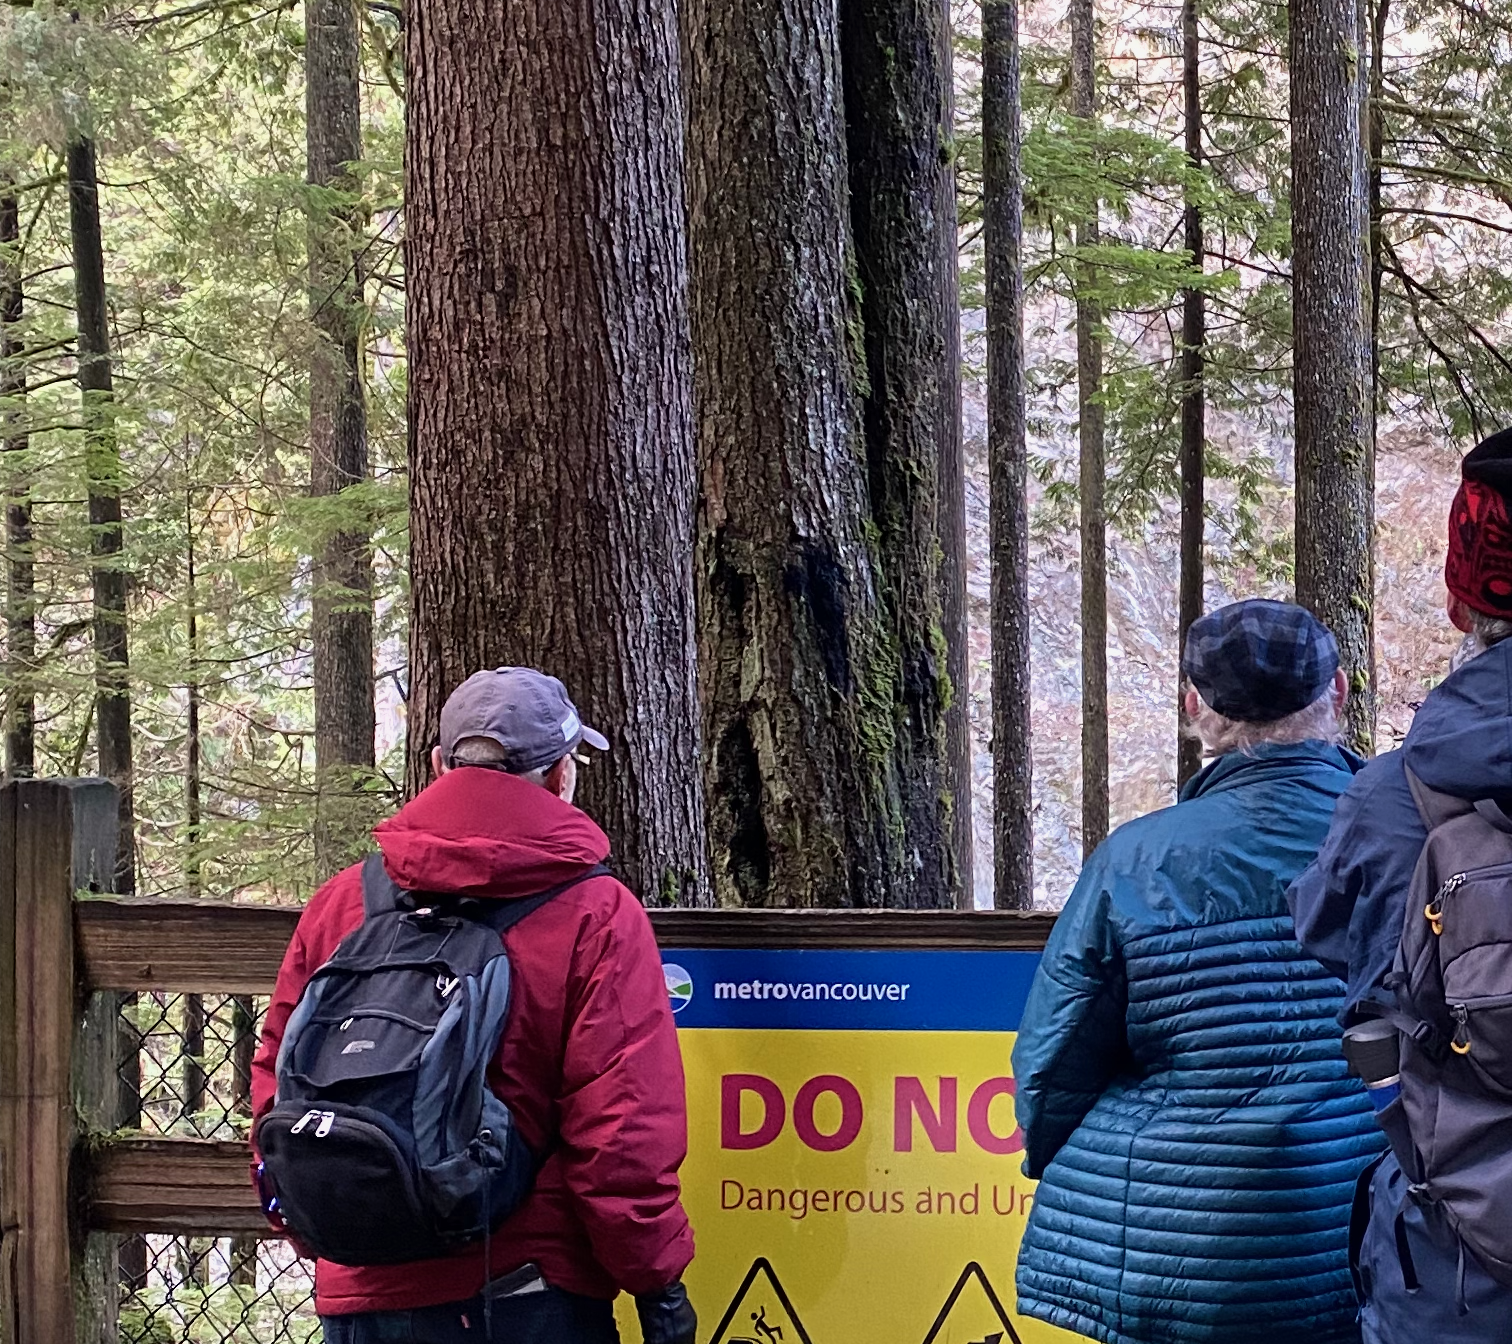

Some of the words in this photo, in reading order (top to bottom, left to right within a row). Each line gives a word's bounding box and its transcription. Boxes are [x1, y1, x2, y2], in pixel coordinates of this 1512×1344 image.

[714, 979, 910, 1001] metrovancouver
[721, 1073, 864, 1152] DO
[721, 1179, 905, 1220] Dangerous
[915, 1182, 979, 1215] and
